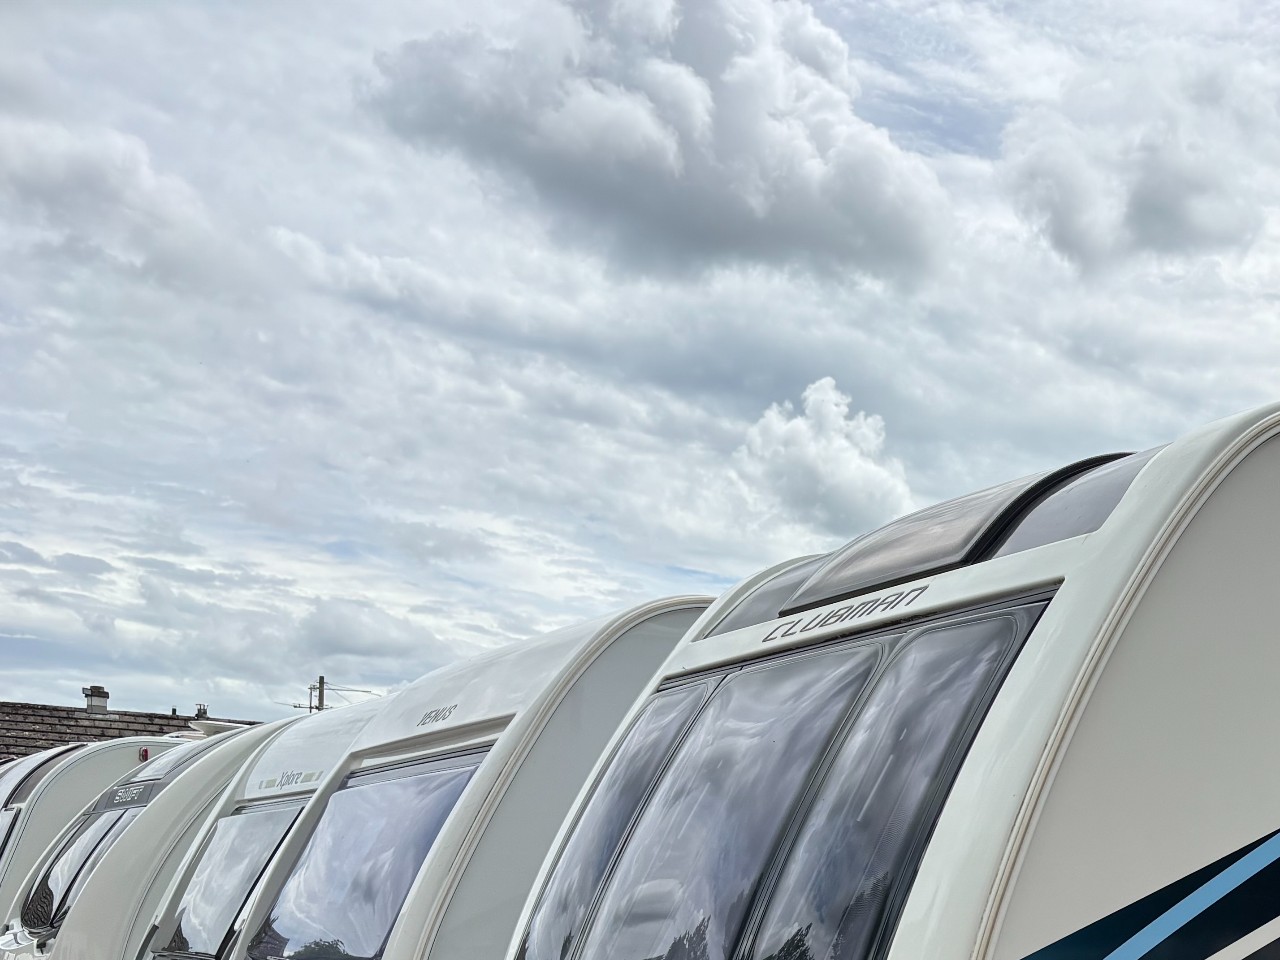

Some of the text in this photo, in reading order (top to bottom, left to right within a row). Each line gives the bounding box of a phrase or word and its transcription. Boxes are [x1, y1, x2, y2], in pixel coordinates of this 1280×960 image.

[762, 584, 930, 643] CLUBMAN
[416, 704, 458, 727] VENUS
[276, 770, 303, 790] Xplore
[113, 785, 145, 803] SWIFT
